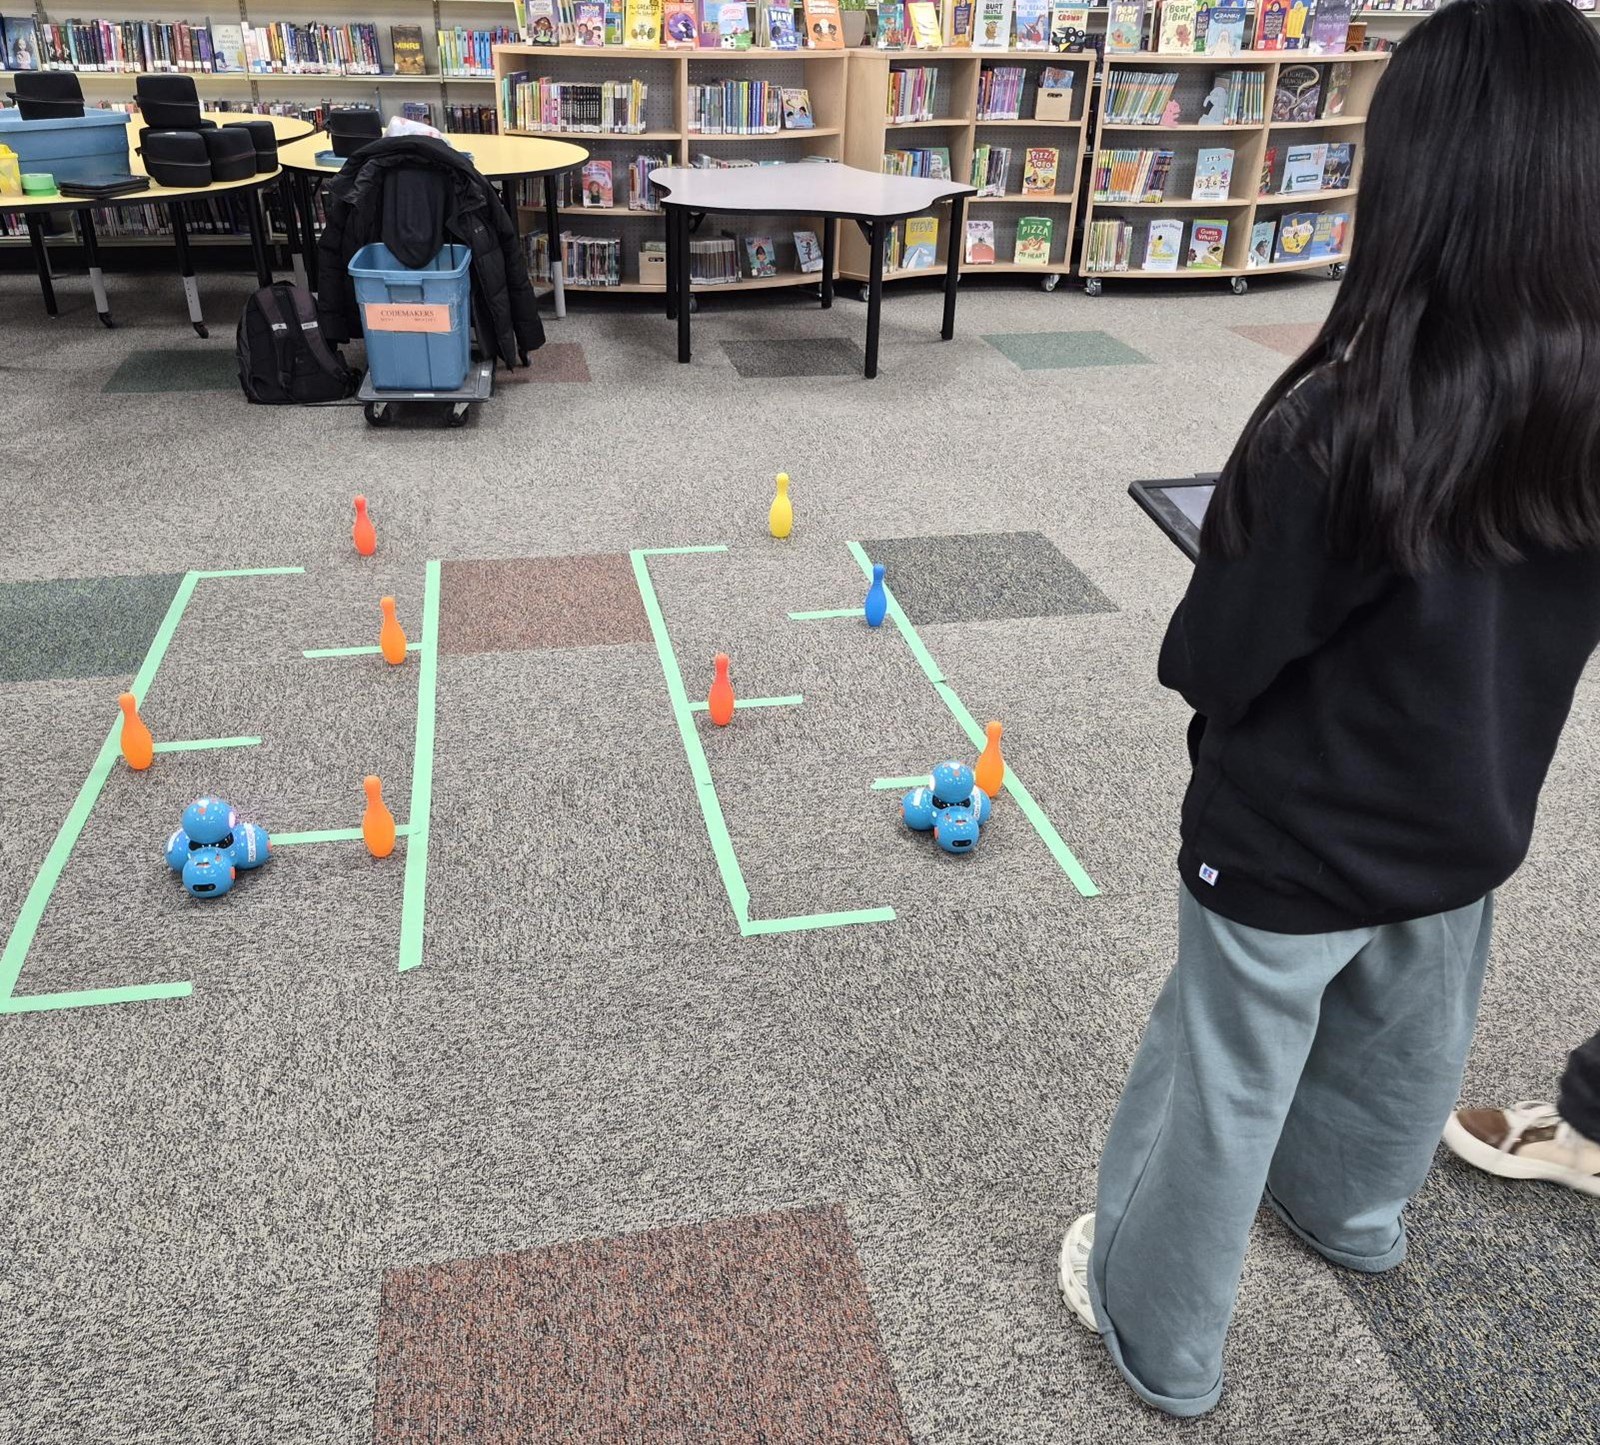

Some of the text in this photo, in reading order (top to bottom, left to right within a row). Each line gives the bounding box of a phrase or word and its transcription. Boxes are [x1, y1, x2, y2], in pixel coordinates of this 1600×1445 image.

[1169, 4, 1192, 13] Bear
[1172, 12, 1191, 21] Bird
[1021, 224, 1049, 237] PIZZA
[1200, 228, 1218, 236] Guess
